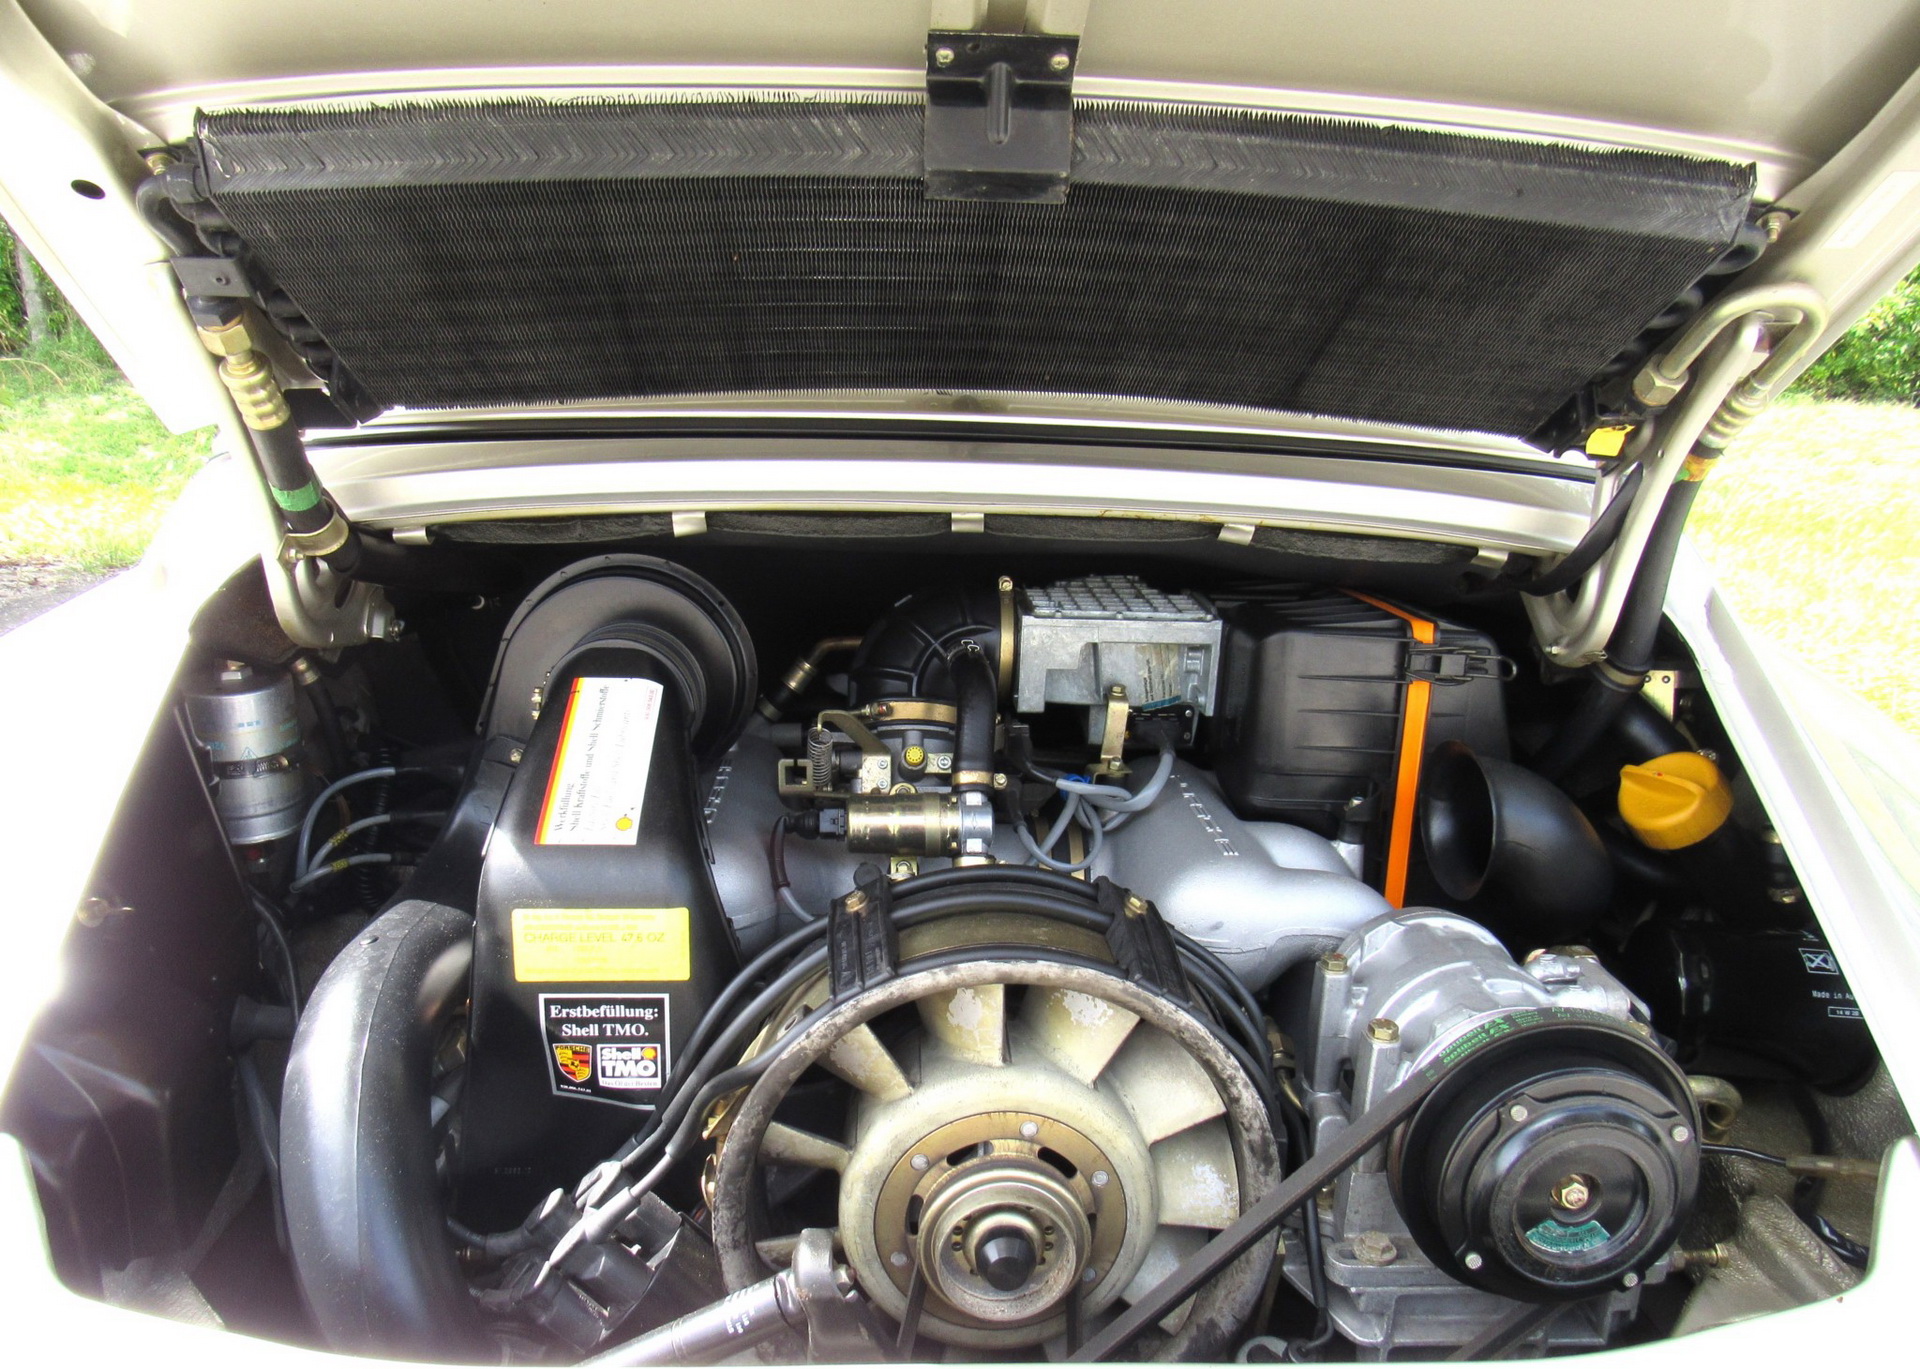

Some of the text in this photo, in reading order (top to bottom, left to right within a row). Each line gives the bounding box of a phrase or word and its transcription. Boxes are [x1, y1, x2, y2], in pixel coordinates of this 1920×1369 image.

[523, 932, 576, 943] CHARGE
[579, 932, 616, 943] LEVEL
[647, 932, 665, 943] OZ
[1812, 990, 1830, 999] Made
[550, 1004, 659, 1021] Erstbefüllung:
[561, 1023, 649, 1036] Shell TMO.
[601, 1047, 641, 1060] Shell
[601, 1060, 656, 1077] TMO
